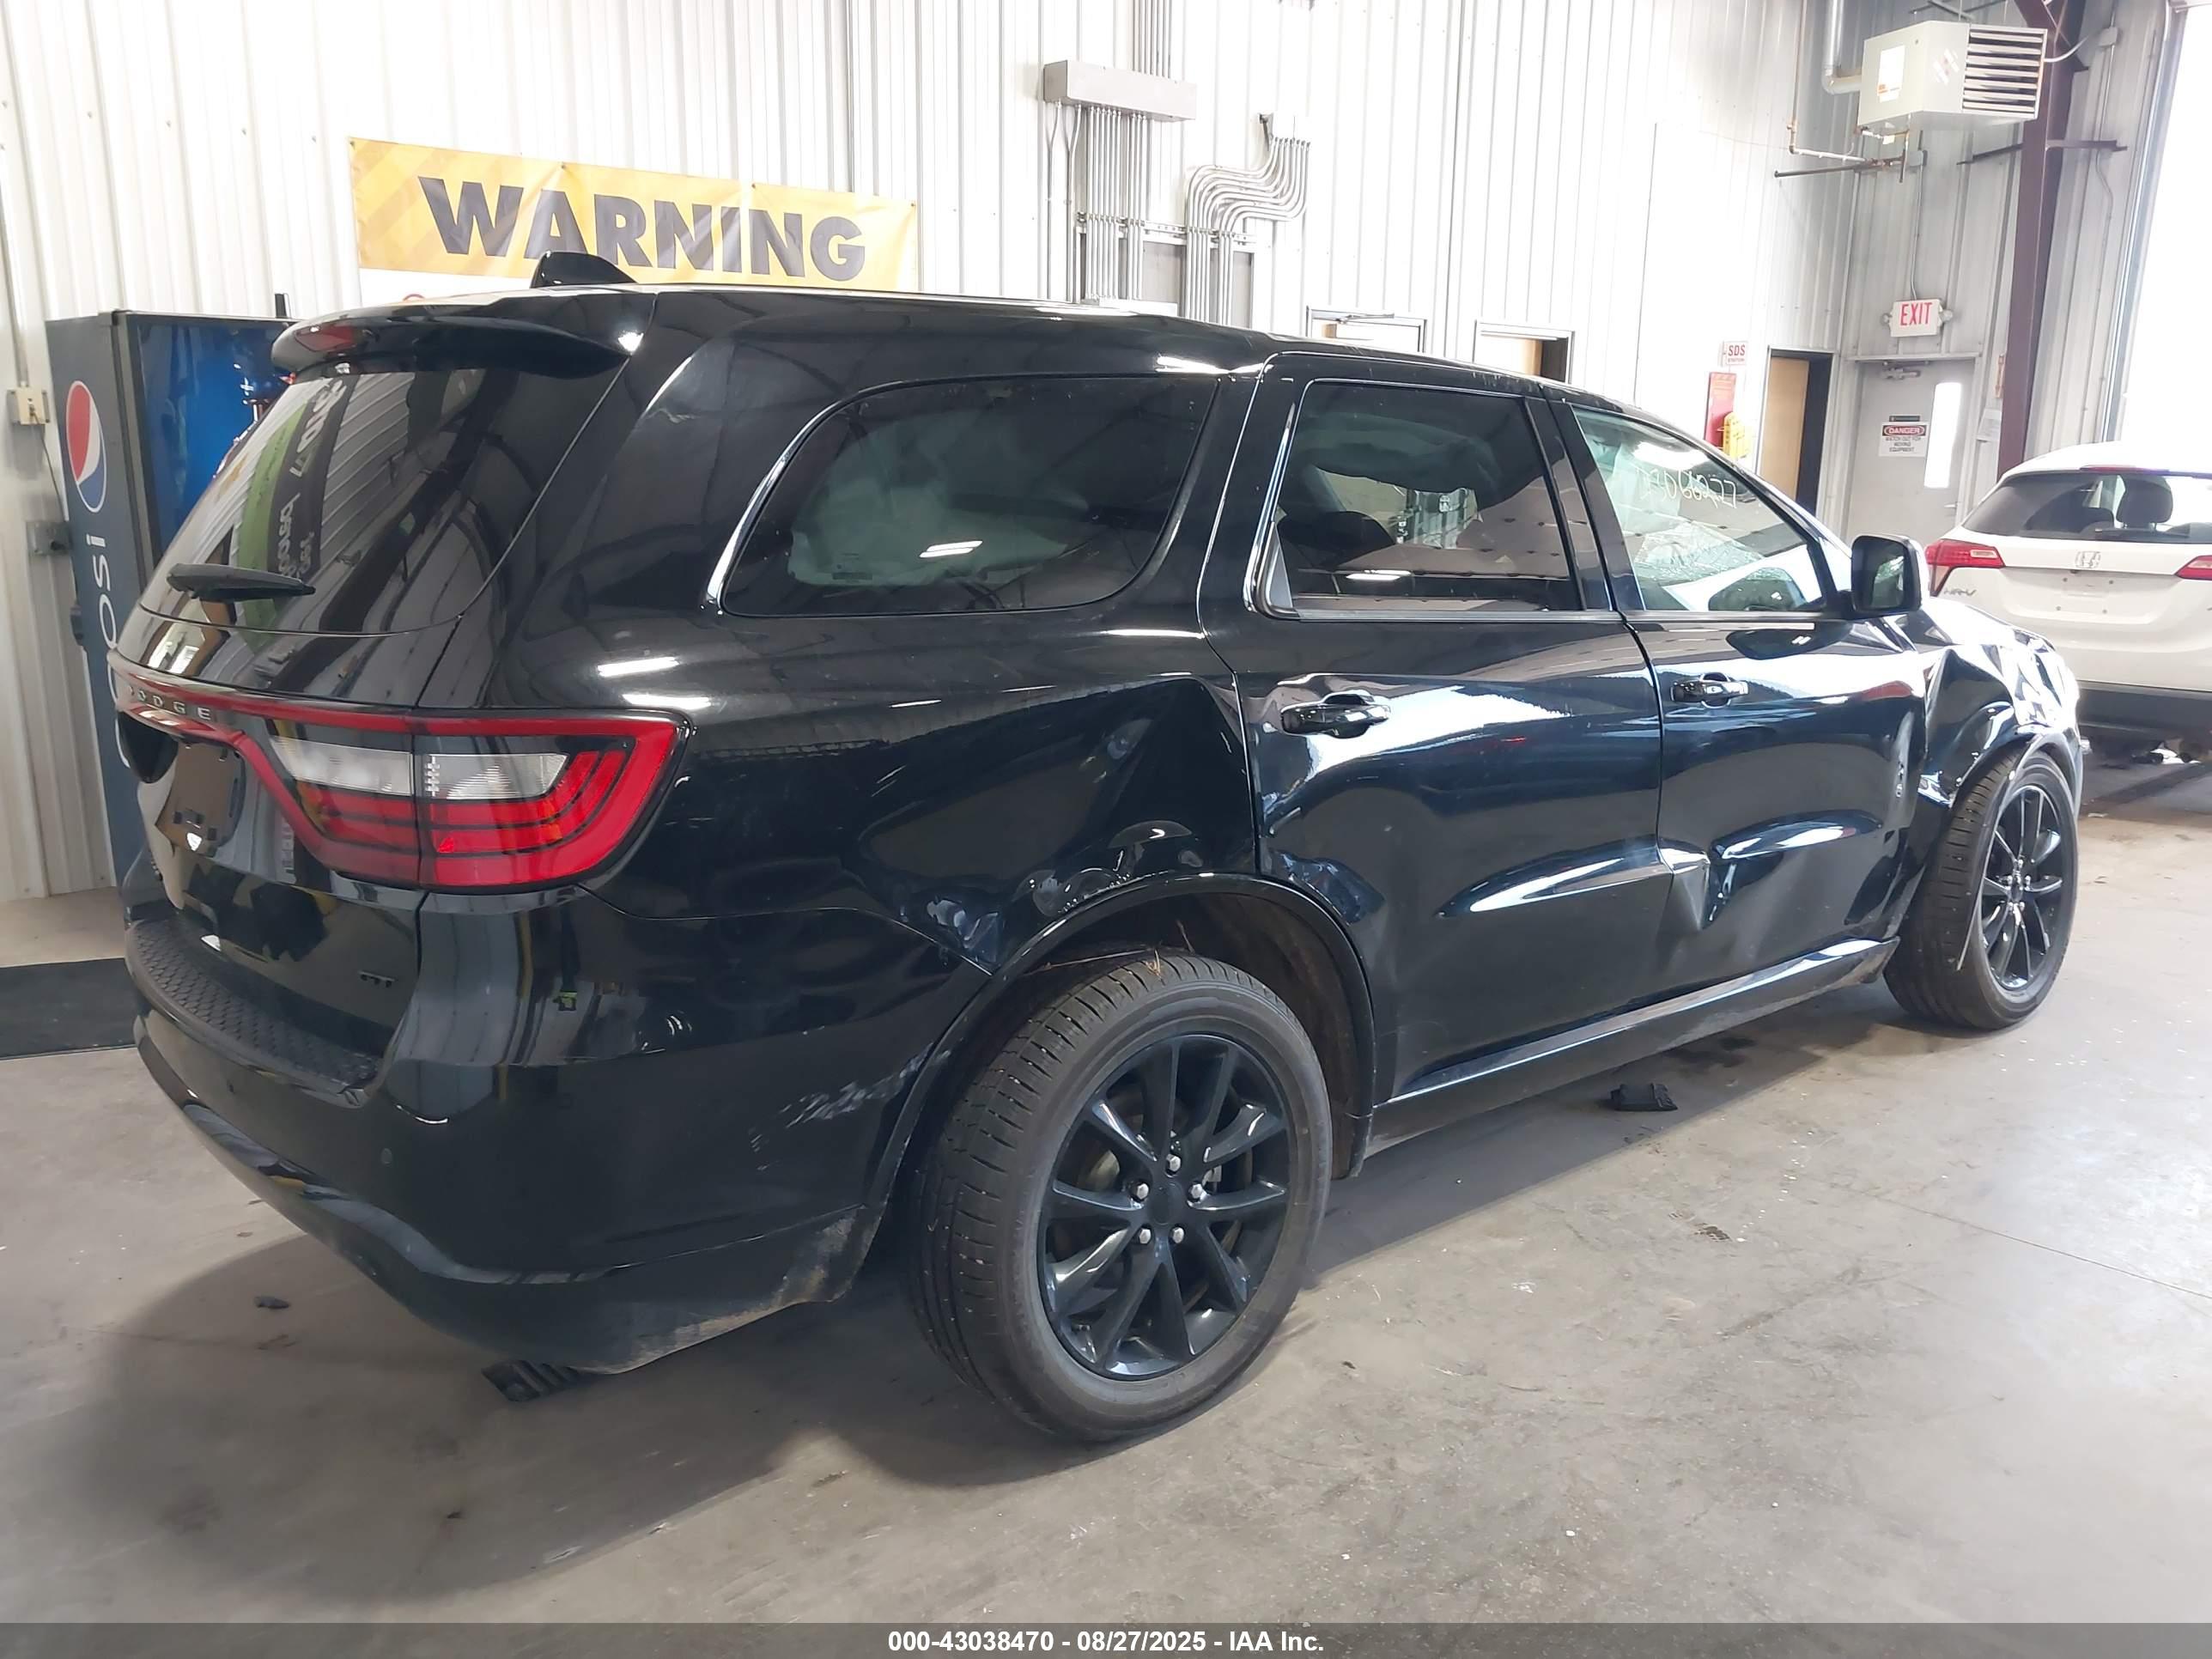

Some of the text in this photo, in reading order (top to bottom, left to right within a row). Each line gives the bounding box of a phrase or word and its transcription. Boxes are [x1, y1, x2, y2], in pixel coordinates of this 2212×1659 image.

[417, 176, 866, 282] WARNING
[1900, 302, 1932, 326] EXIT
[1728, 344, 1746, 356] SDS
